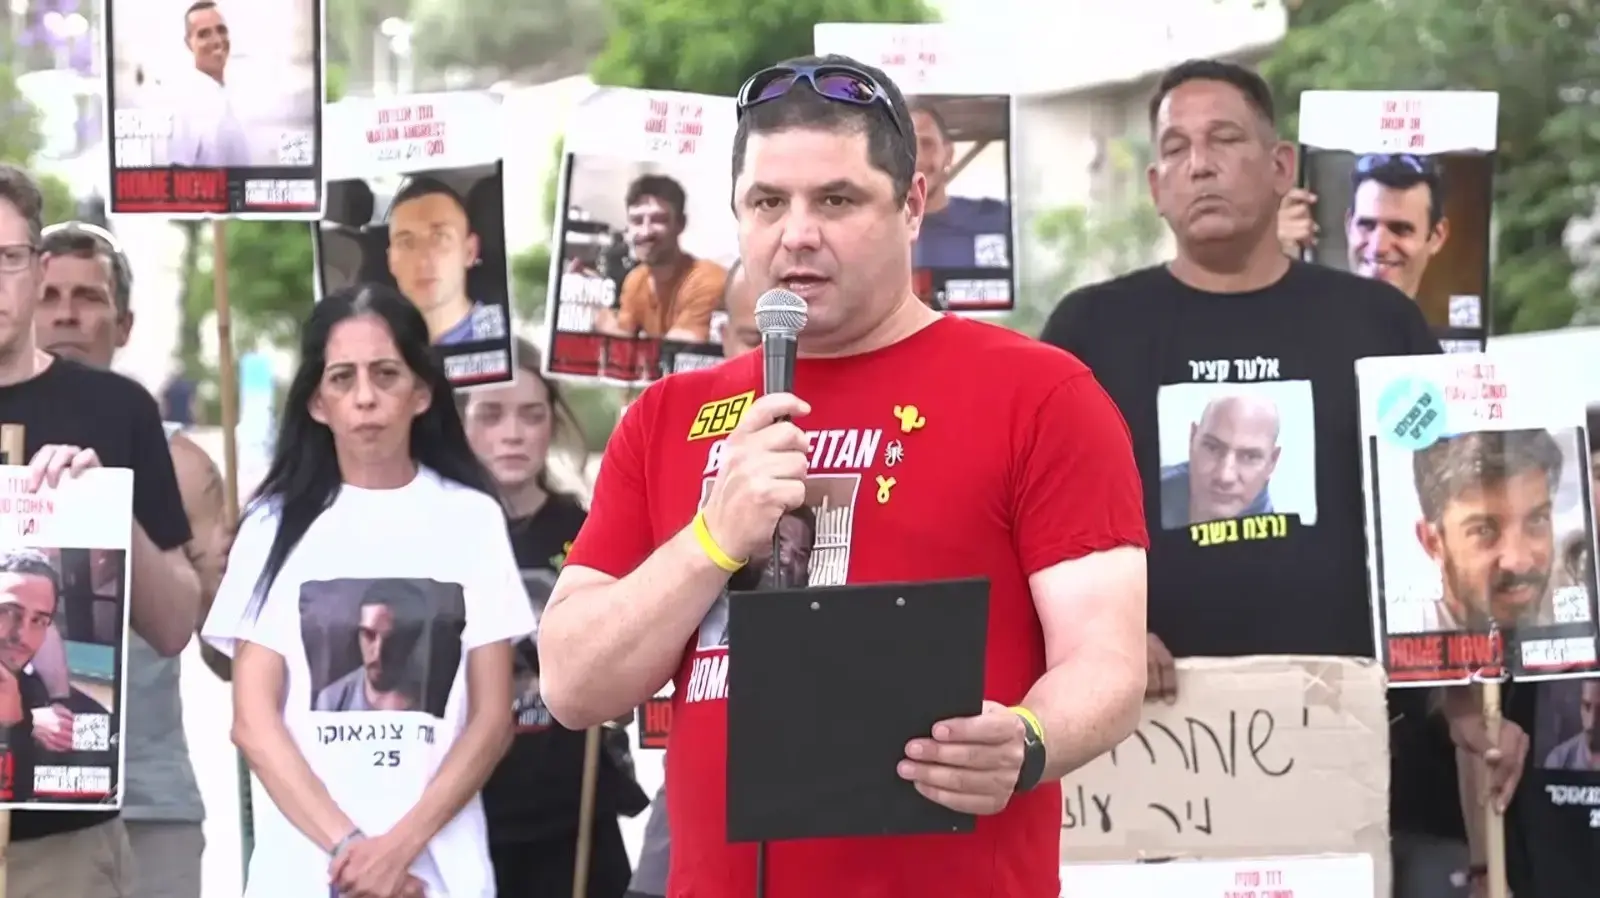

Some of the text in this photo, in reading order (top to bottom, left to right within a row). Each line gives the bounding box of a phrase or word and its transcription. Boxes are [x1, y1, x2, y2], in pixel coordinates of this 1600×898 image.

[118, 171, 169, 200] HOME
[1187, 355, 1280, 383] אלעד קציר
[690, 396, 749, 438] 589
[17, 498, 54, 514] COHEN
[1190, 514, 1287, 547] נרצח בשבי
[1388, 636, 1442, 669] HOME
[686, 656, 729, 704] HOM
[373, 750, 400, 767] 25
[1148, 796, 1213, 834] ניר
